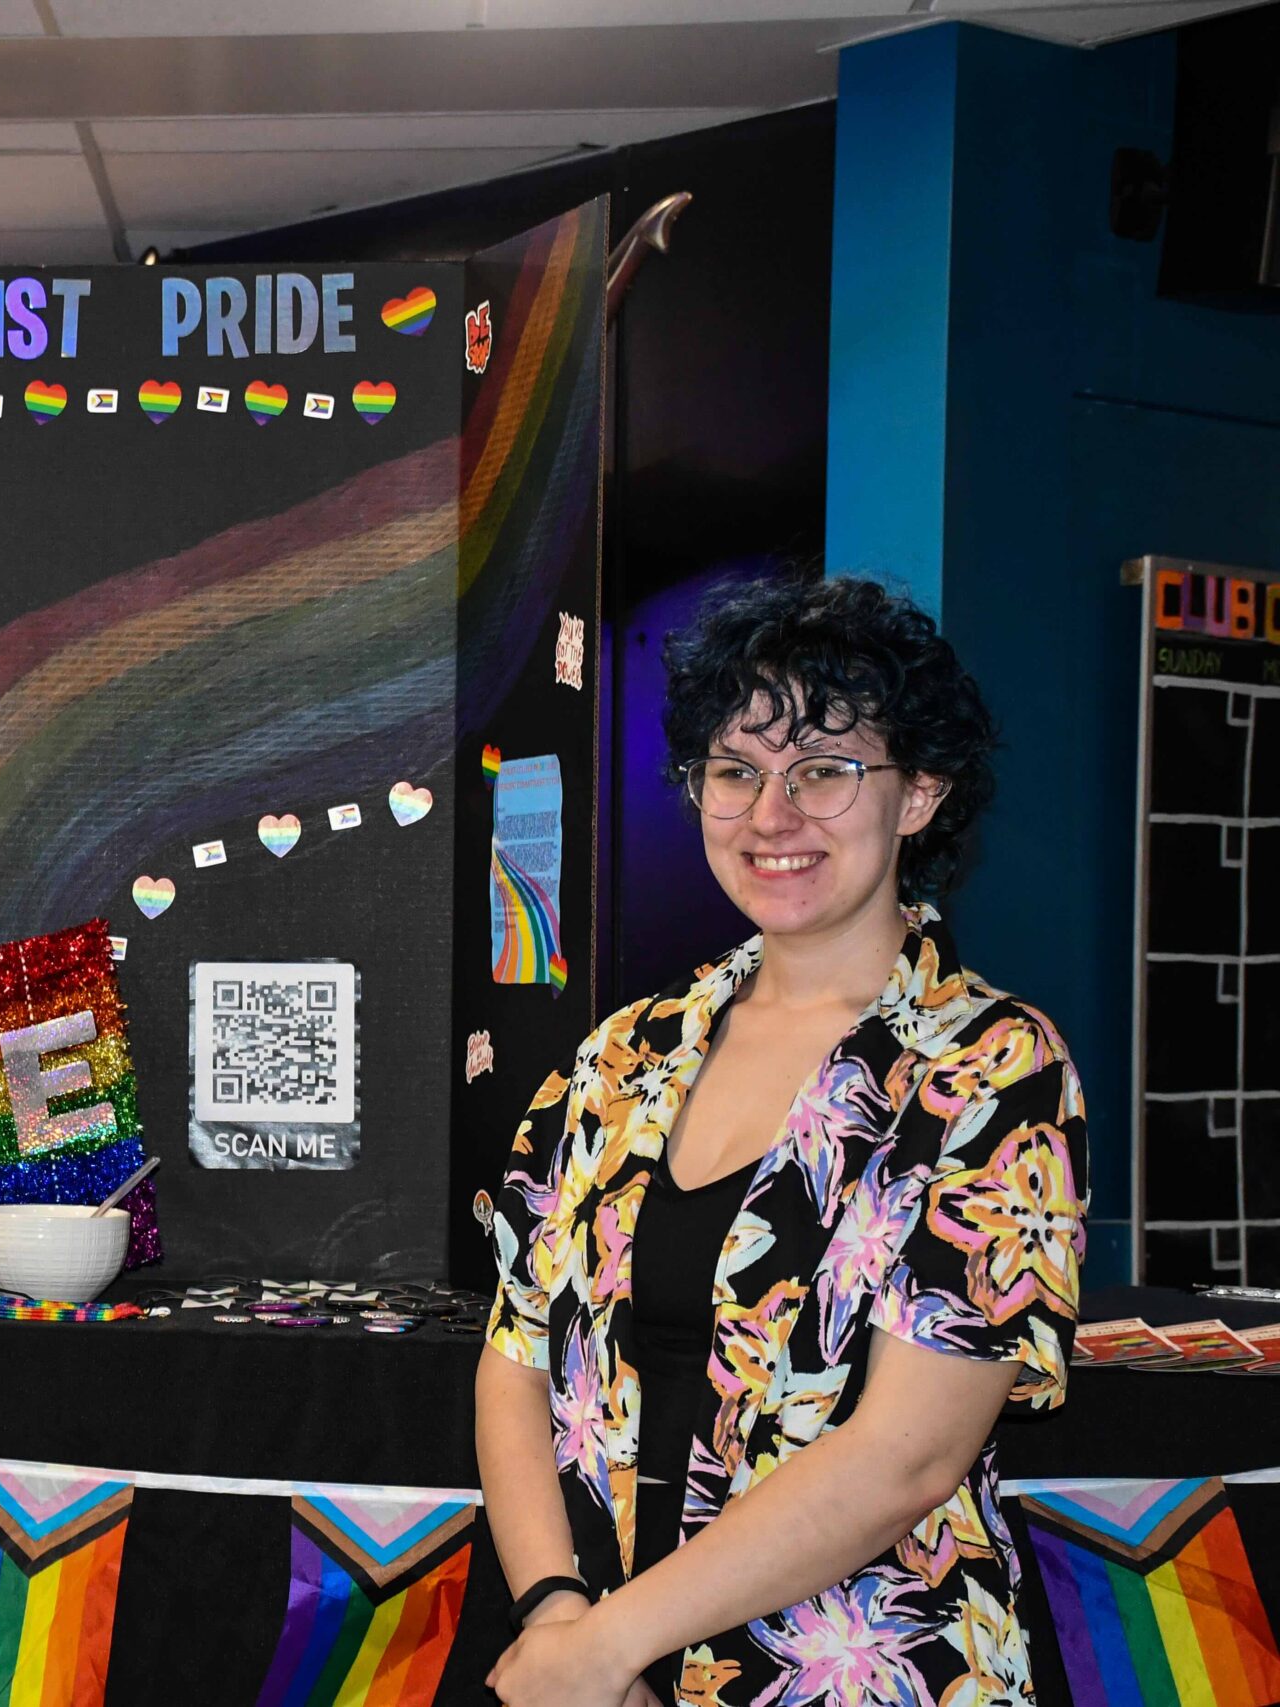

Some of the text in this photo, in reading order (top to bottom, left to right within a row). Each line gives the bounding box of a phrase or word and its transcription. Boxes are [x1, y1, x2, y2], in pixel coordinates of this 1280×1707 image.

[161, 272, 356, 359] PRIDE
[214, 1133, 336, 1158] SCAN ME
